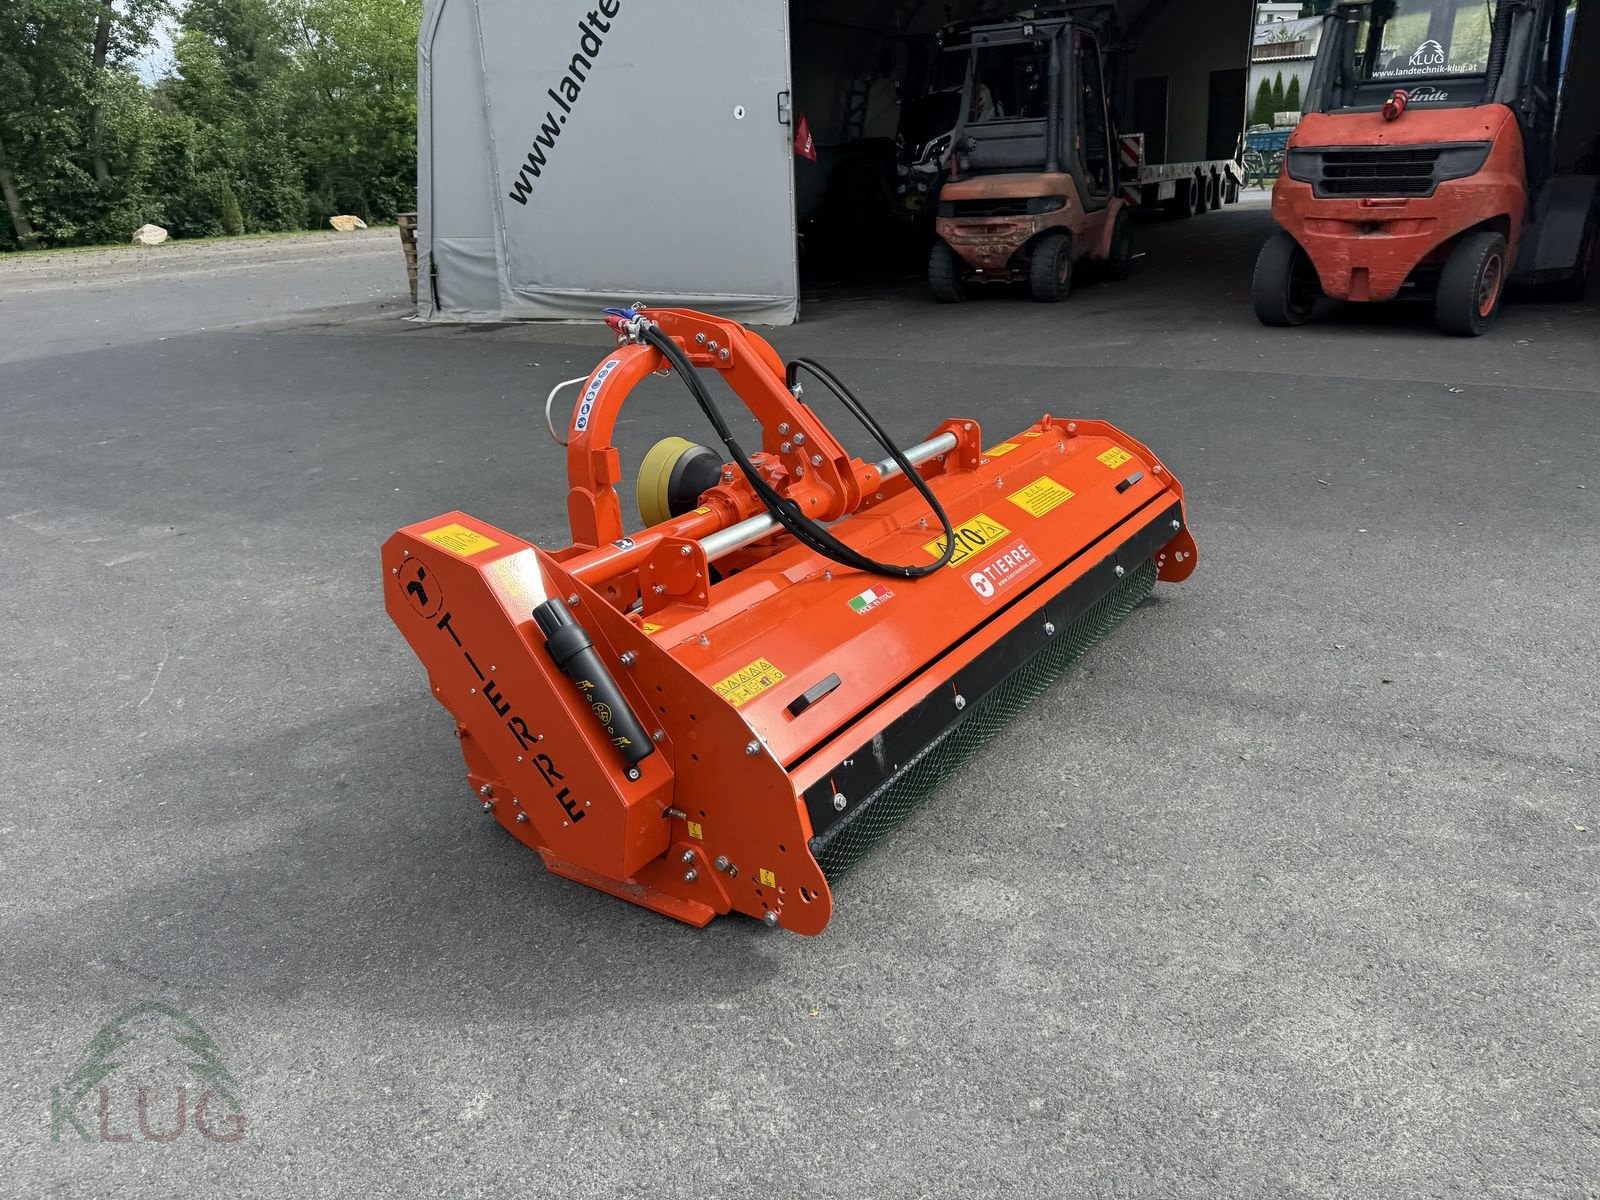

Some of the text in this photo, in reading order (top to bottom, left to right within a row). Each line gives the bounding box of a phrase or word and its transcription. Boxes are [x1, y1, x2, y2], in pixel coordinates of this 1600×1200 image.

[1372, 63, 1478, 78] www.landtechnik-klug.at
[1408, 54, 1445, 66] KLUG
[983, 544, 1031, 581] TIERRE
[436, 611, 586, 824] TIERRE
